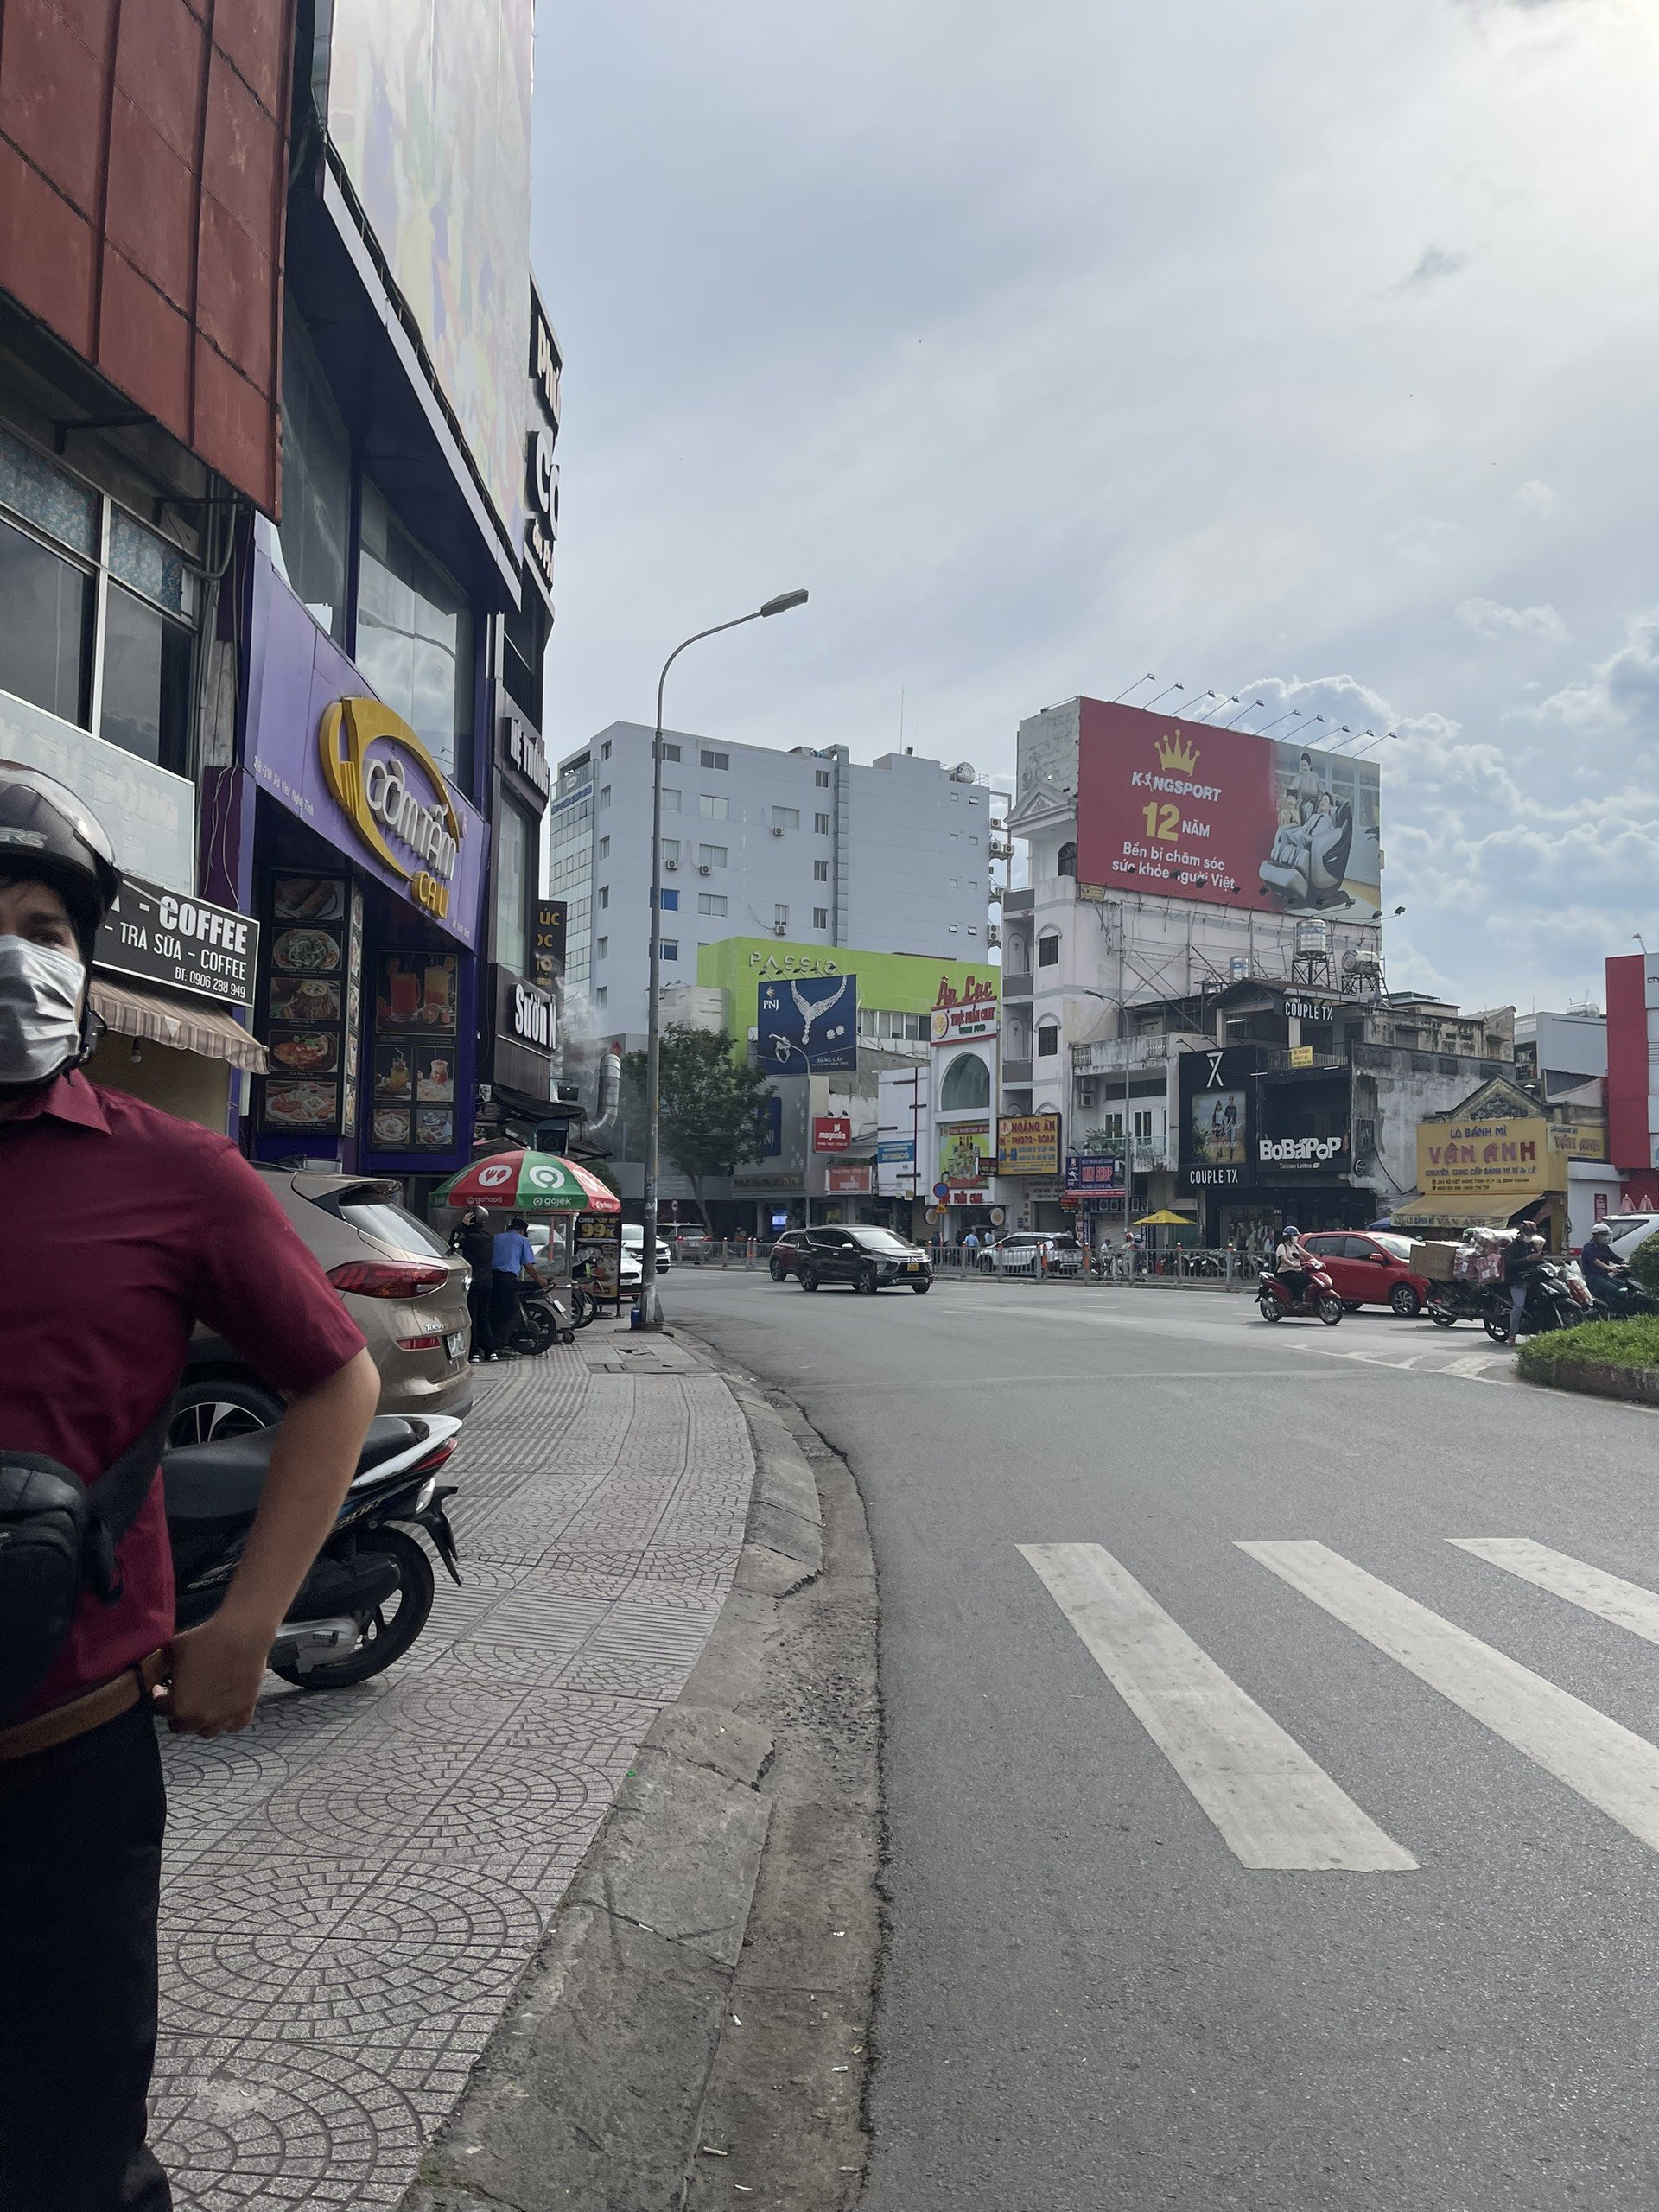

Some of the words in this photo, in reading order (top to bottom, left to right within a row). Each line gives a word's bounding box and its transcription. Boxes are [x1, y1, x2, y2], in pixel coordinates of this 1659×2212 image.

[1142, 802, 1180, 842] 12
[1182, 819, 1211, 838] NĂM
[1123, 841, 1147, 858] Bền
[1166, 850, 1201, 867] chăm
[1203, 856, 1225, 871] sóc
[1211, 873, 1236, 892] Việt
[159, 895, 249, 956] COFFEE
[120, 921, 148, 950] TRÀ
[153, 933, 182, 961] SỮA
[200, 949, 247, 981] COFFEE
[189, 970, 211, 988] 0906
[213, 977, 229, 994] 288
[230, 982, 246, 999] 949
[515, 983, 547, 1046] Sườn
[763, 999, 779, 1011] PNJ
[1285, 1001, 1319, 1020] COUPLE
[1321, 1006, 1333, 1020] TX
[1011, 1120, 1040, 1134] HOÀNG
[1450, 1127, 1462, 1139] LÒ
[1465, 1125, 1491, 1138] BÁNH
[1495, 1124, 1508, 1137] MÌ
[1012, 1135, 1033, 1145] PHOTO
[1038, 1134, 1056, 1143] SCAN
[1428, 1142, 1477, 1165] VÂN
[1483, 1141, 1536, 1164] ANH
[1095, 1166, 1113, 1182] SHOP
[1190, 1169, 1224, 1185] COUPLE
[1226, 1169, 1238, 1183] TX
[475, 1196, 502, 1205] gofood
[544, 1197, 571, 1205] gojek
